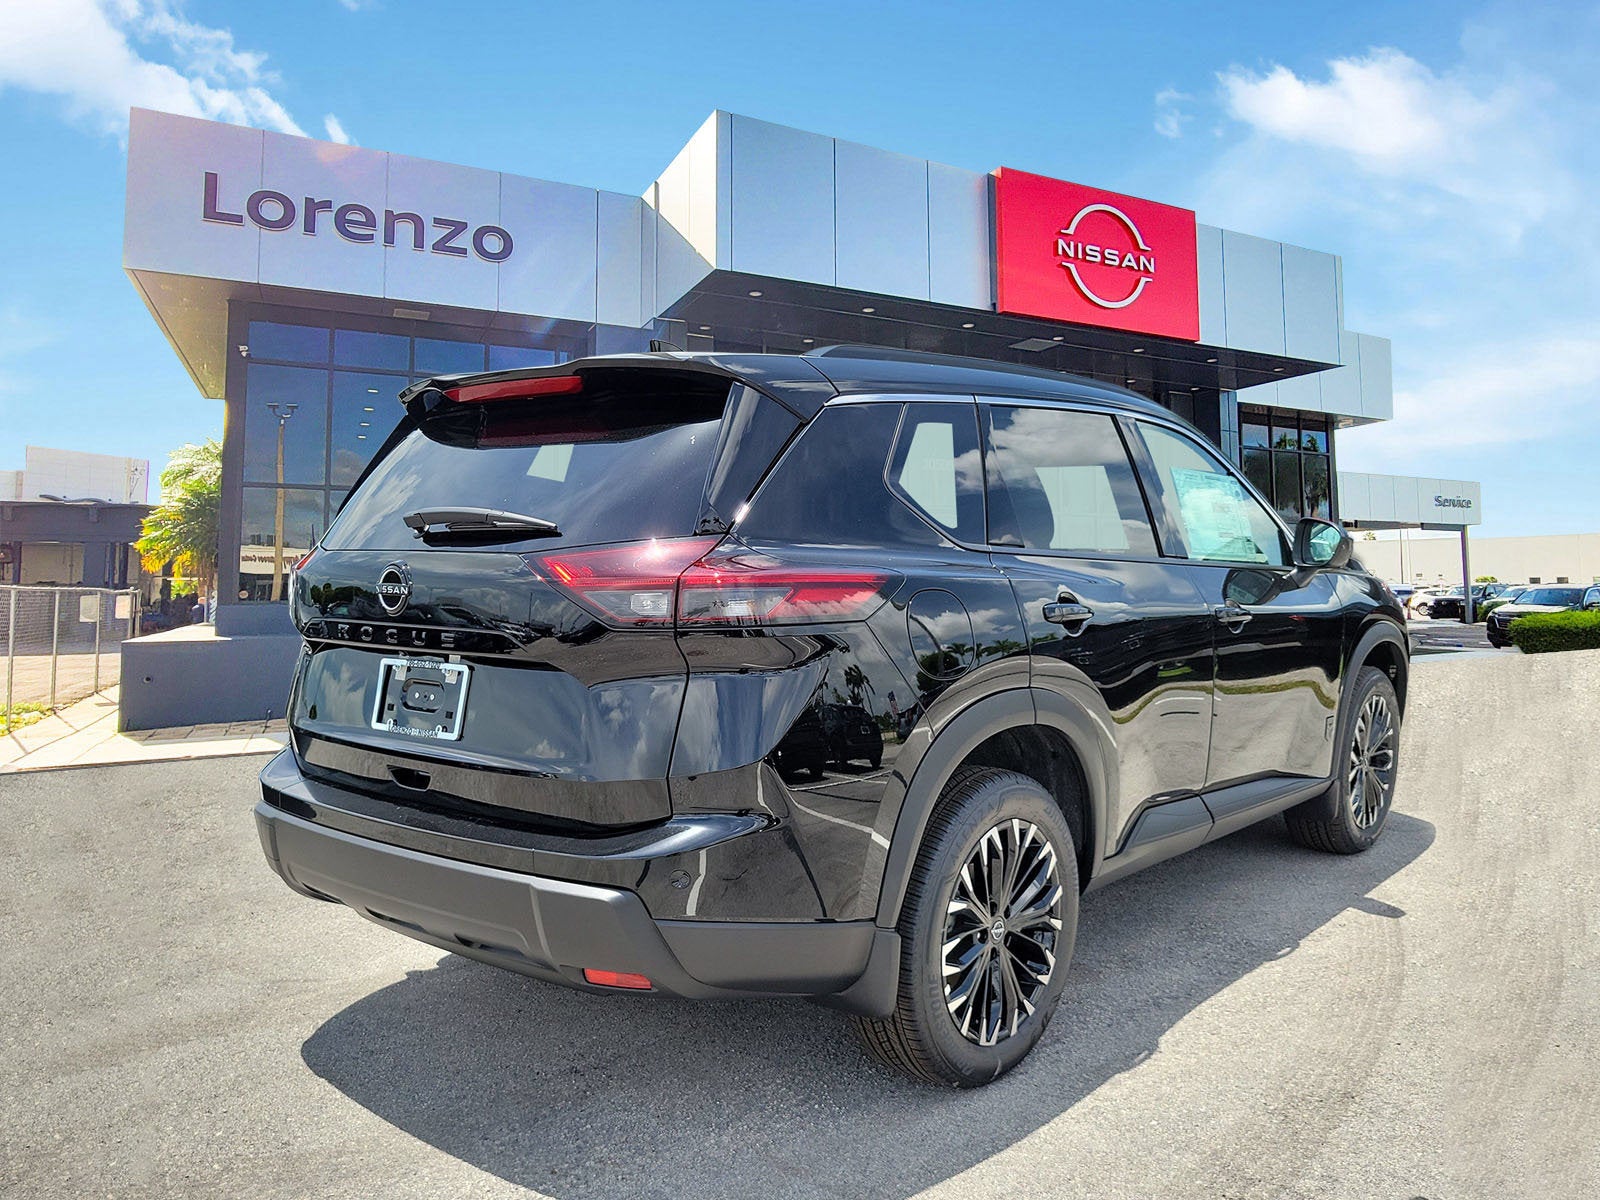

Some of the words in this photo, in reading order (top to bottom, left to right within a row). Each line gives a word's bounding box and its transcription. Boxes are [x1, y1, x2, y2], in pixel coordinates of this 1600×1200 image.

[202, 171, 514, 262] Lorenzo
[1057, 238, 1156, 273] NISSAN
[1434, 495, 1472, 509] Service
[376, 585, 409, 595] NSSAN
[337, 623, 456, 648] ROGUE
